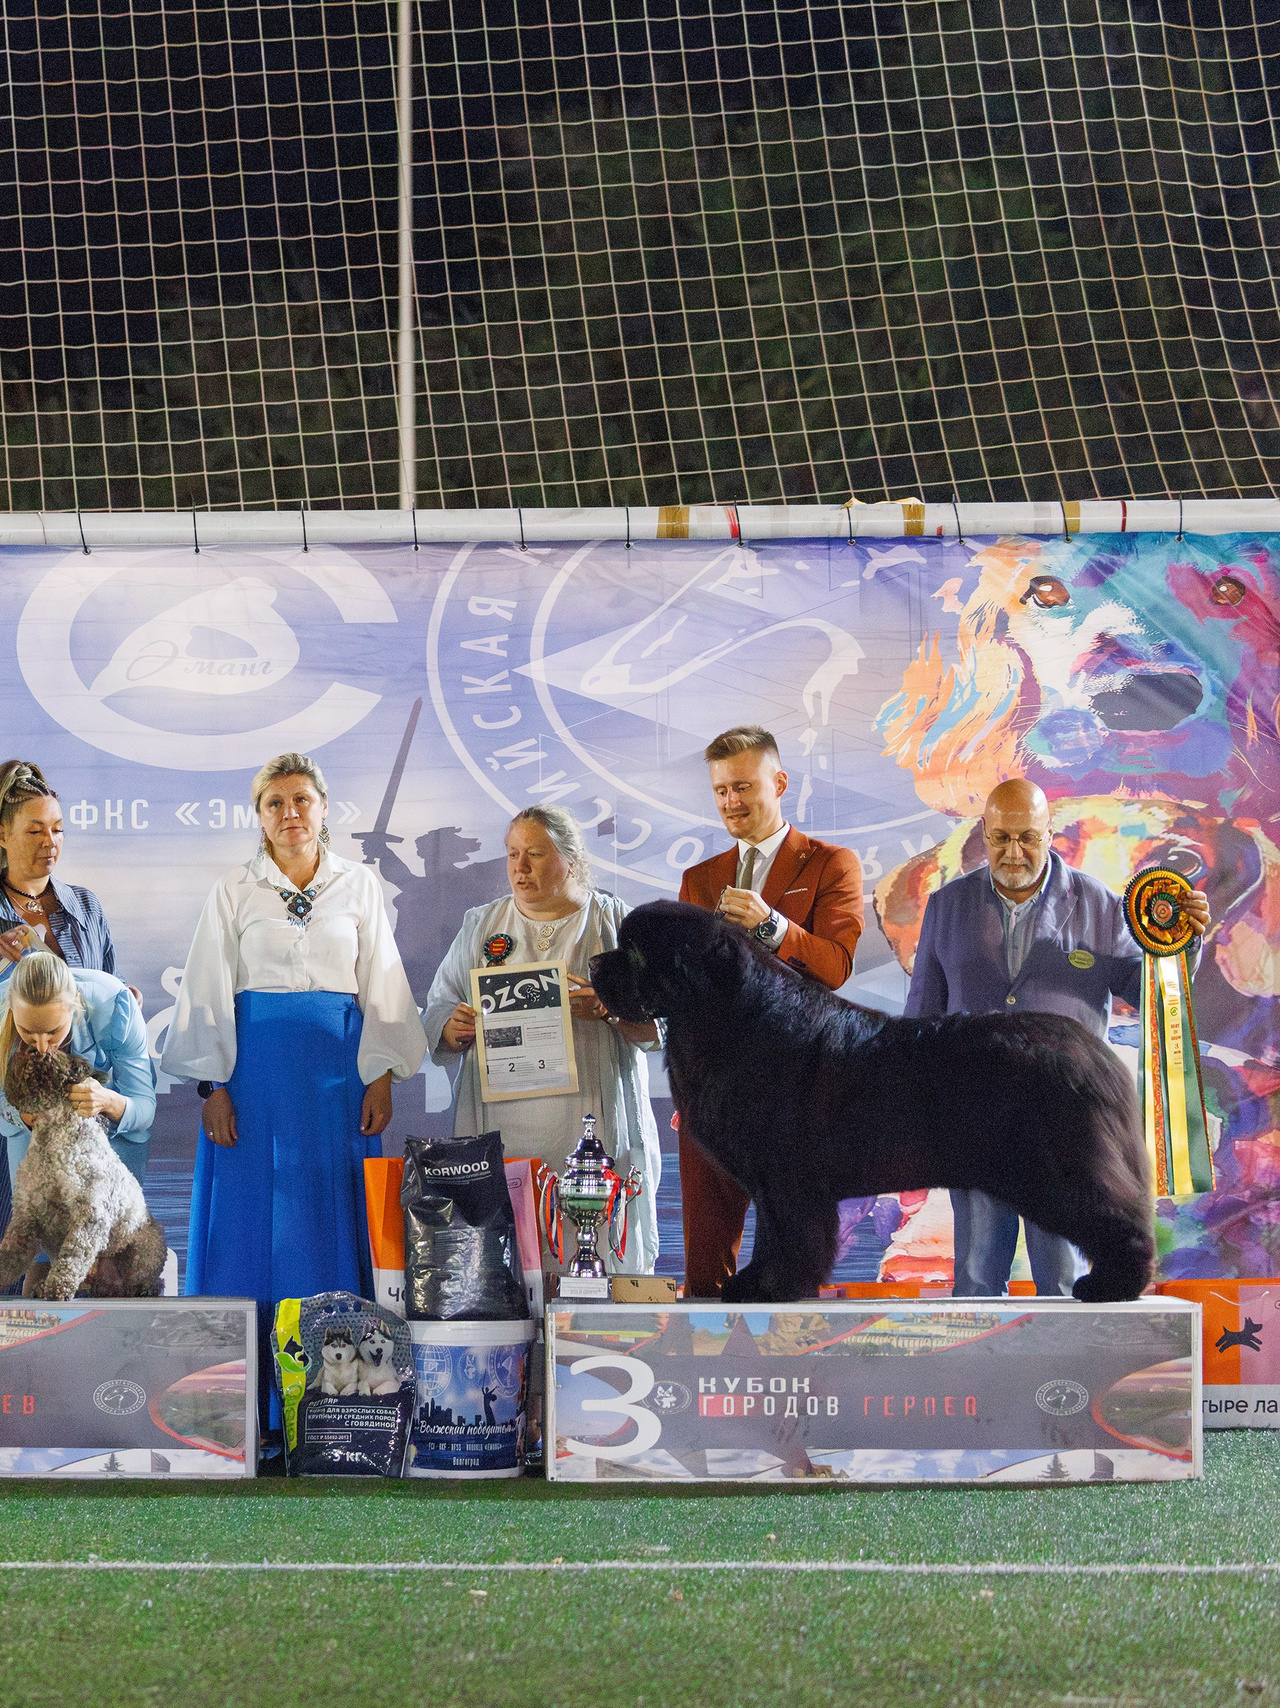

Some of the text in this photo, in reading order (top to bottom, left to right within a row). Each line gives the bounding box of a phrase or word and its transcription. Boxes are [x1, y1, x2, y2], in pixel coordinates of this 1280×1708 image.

[509, 1062, 516, 1072] 2
[538, 1060, 546, 1069] 3
[424, 1160, 490, 1177] KORWOOD
[699, 1377, 810, 1394] КУБОК
[569, 1355, 664, 1458] 3
[702, 1396, 839, 1417] ГОРОДОВ
[1254, 1399, 1278, 1413] ла
